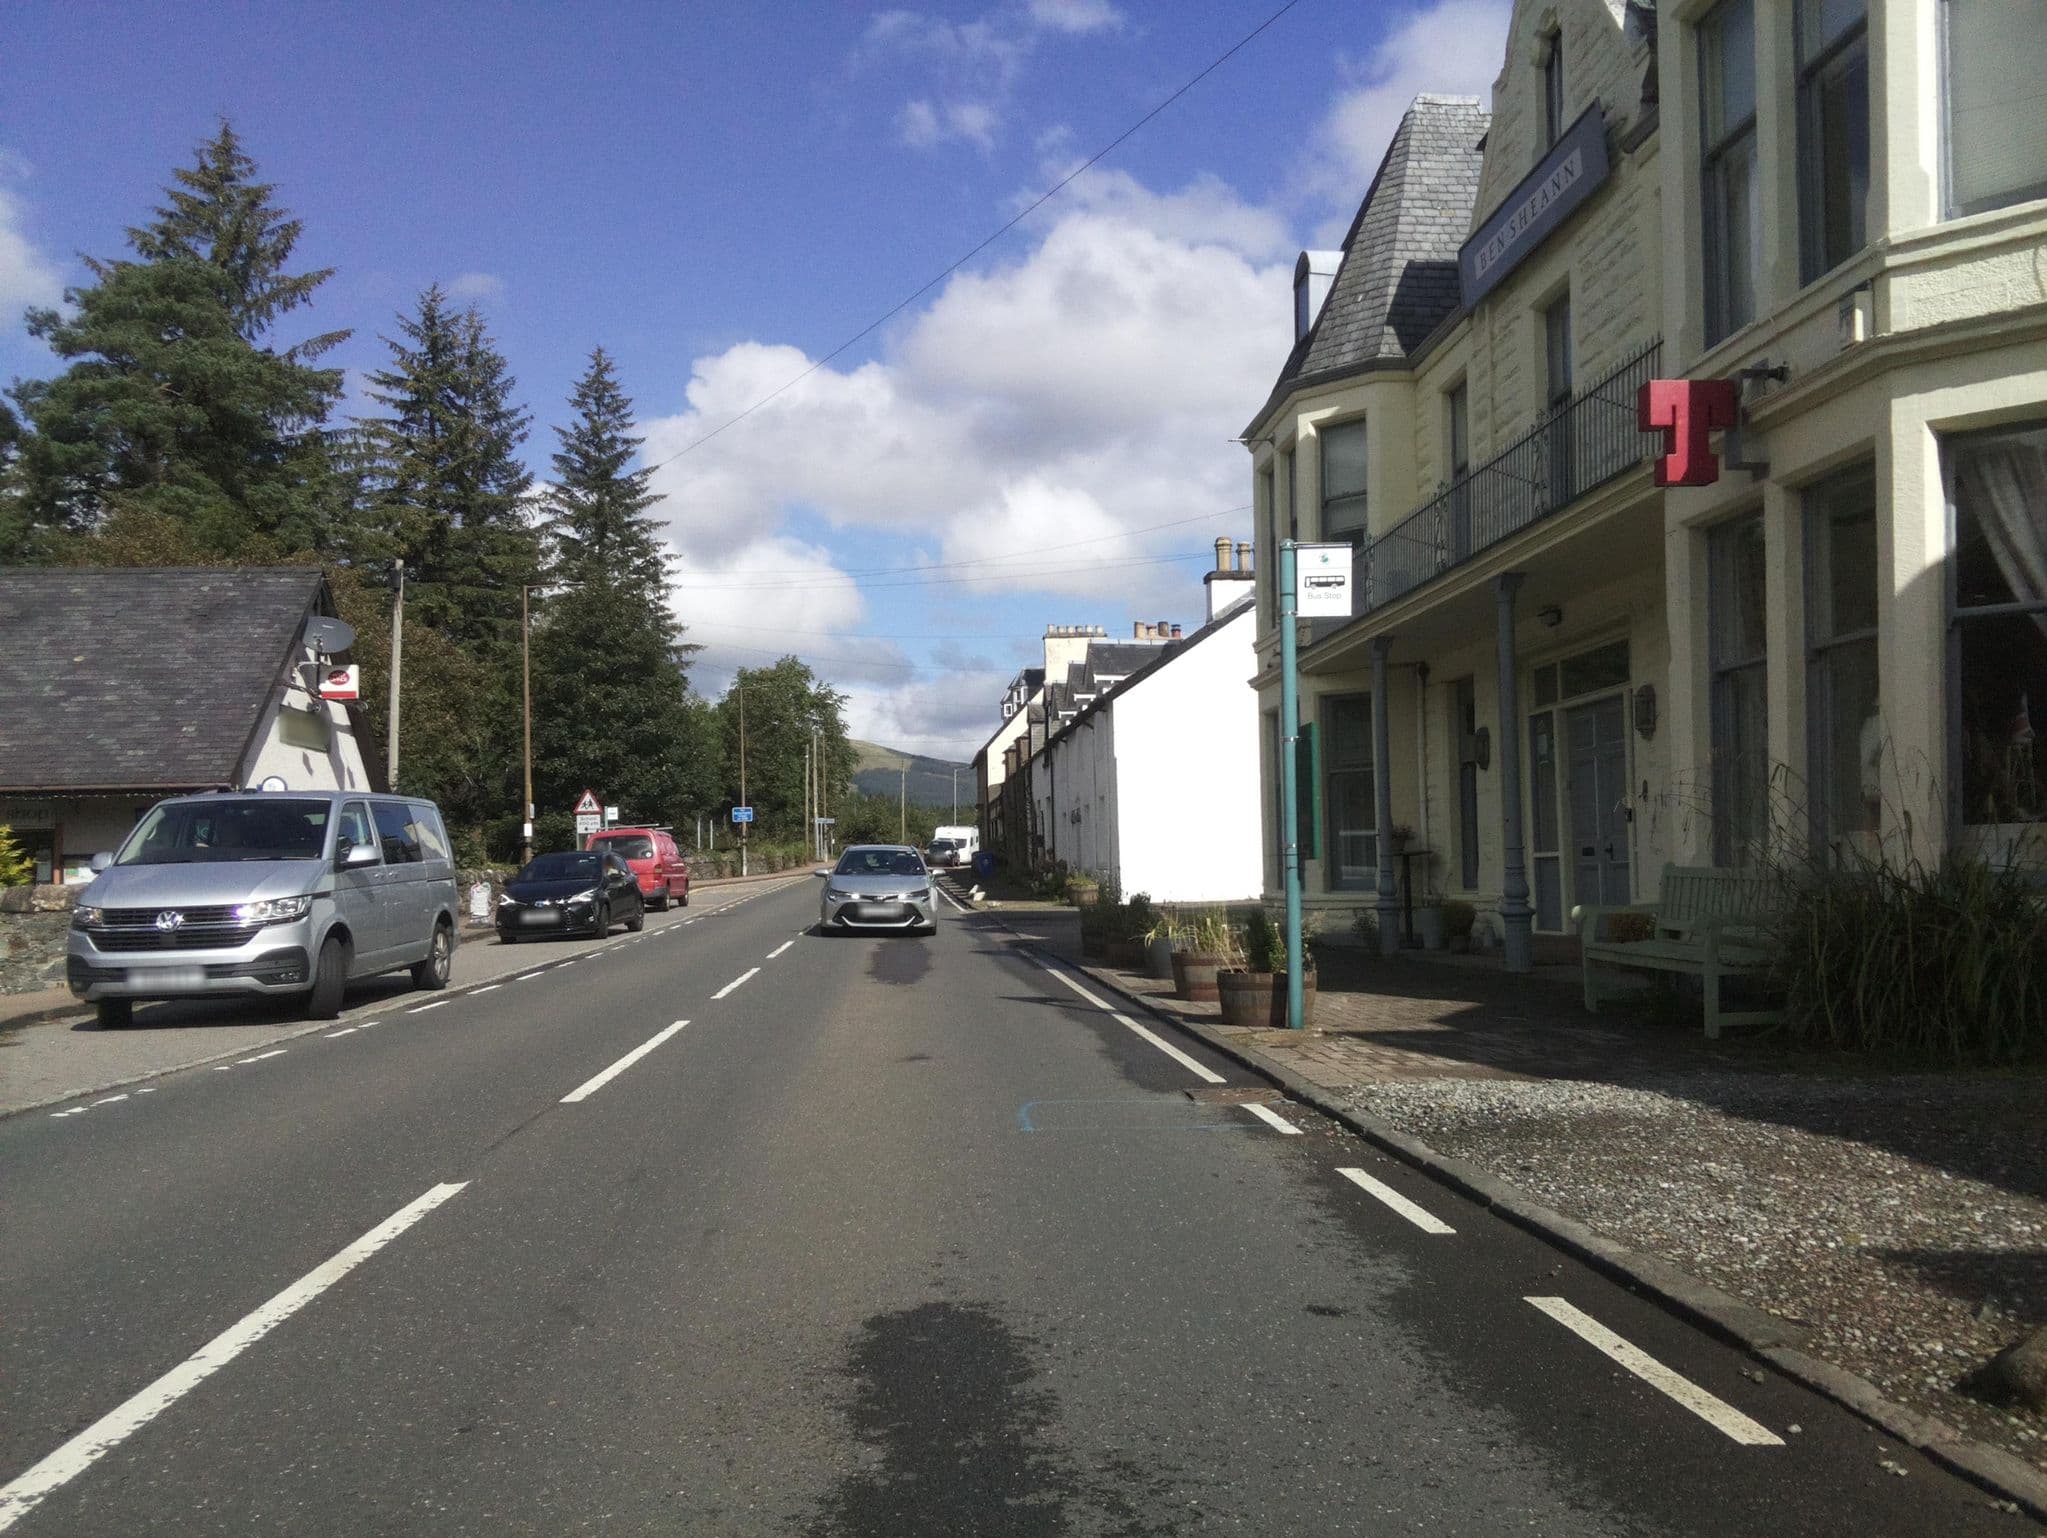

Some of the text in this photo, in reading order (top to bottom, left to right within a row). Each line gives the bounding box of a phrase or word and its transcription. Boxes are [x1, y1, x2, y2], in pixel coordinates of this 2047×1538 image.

[1480, 160, 1578, 270] BEN SHEANN
[1307, 592, 1342, 600] Bus Stop
